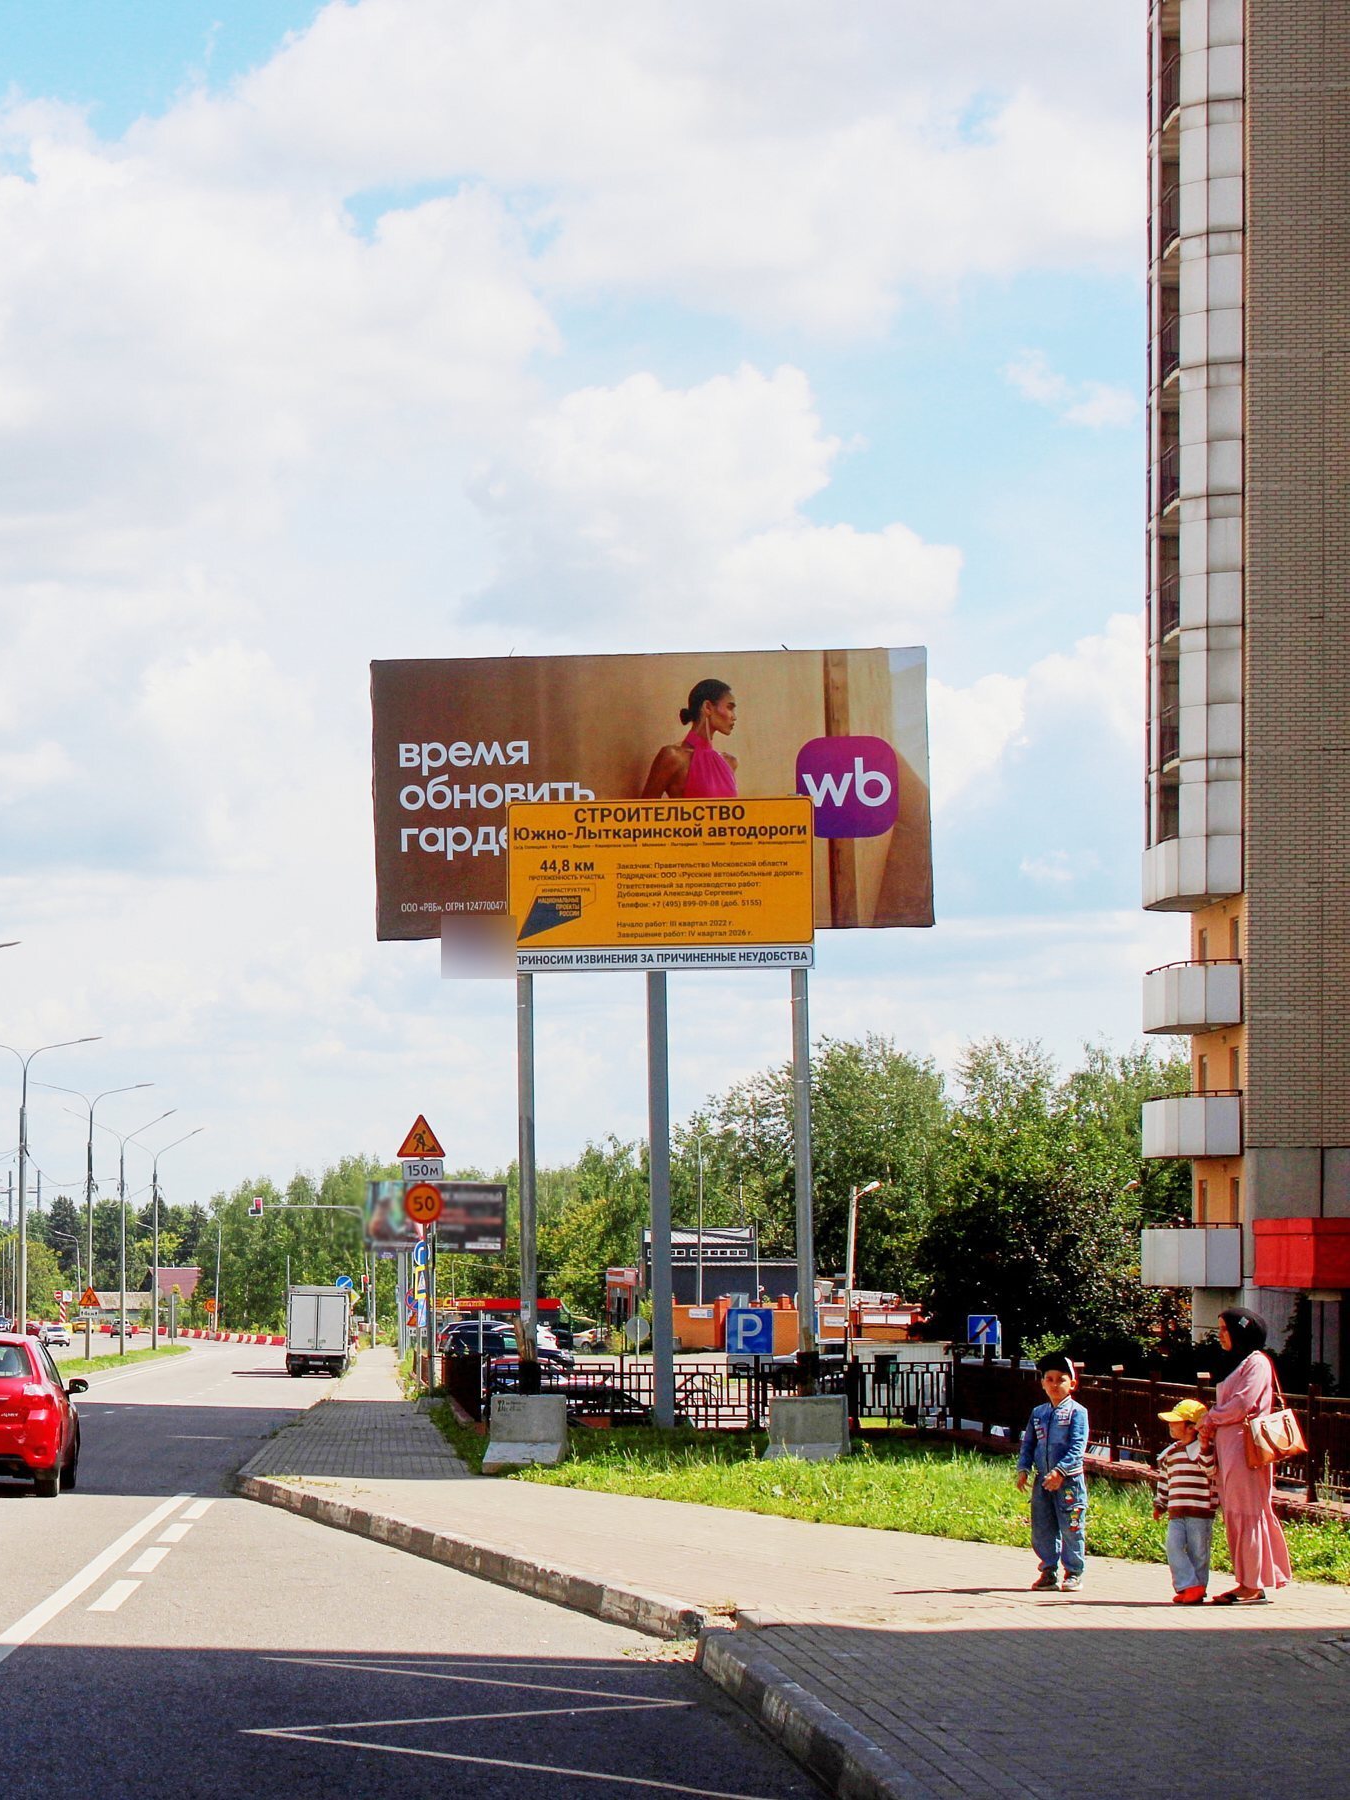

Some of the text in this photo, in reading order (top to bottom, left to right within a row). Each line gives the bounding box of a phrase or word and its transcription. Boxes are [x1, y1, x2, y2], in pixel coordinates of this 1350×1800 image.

[399, 740, 529, 776] время
[802, 757, 892, 807] wb
[400, 774, 596, 810] обновить
[574, 805, 745, 823] СТРОИТЕЛЬСТВО
[514, 824, 806, 842] Южно-Лыткаринской автодороги
[540, 859, 594, 874] 44,8 км
[616, 872, 658, 880] Подрядчик:
[617, 890, 661, 898] Дубовицкий
[401, 903, 418, 912] ООО
[445, 902, 464, 911] ОГРН
[576, 954, 638, 964] ИЗВИНЕНИЯ
[640, 953, 655, 963] ЗА
[657, 952, 736, 962] ПРИЧИНЕННЫЕ
[739, 951, 808, 961] НЕУДОБСТВА
[414, 1196, 435, 1212] 50
[737, 1314, 762, 1349] P
